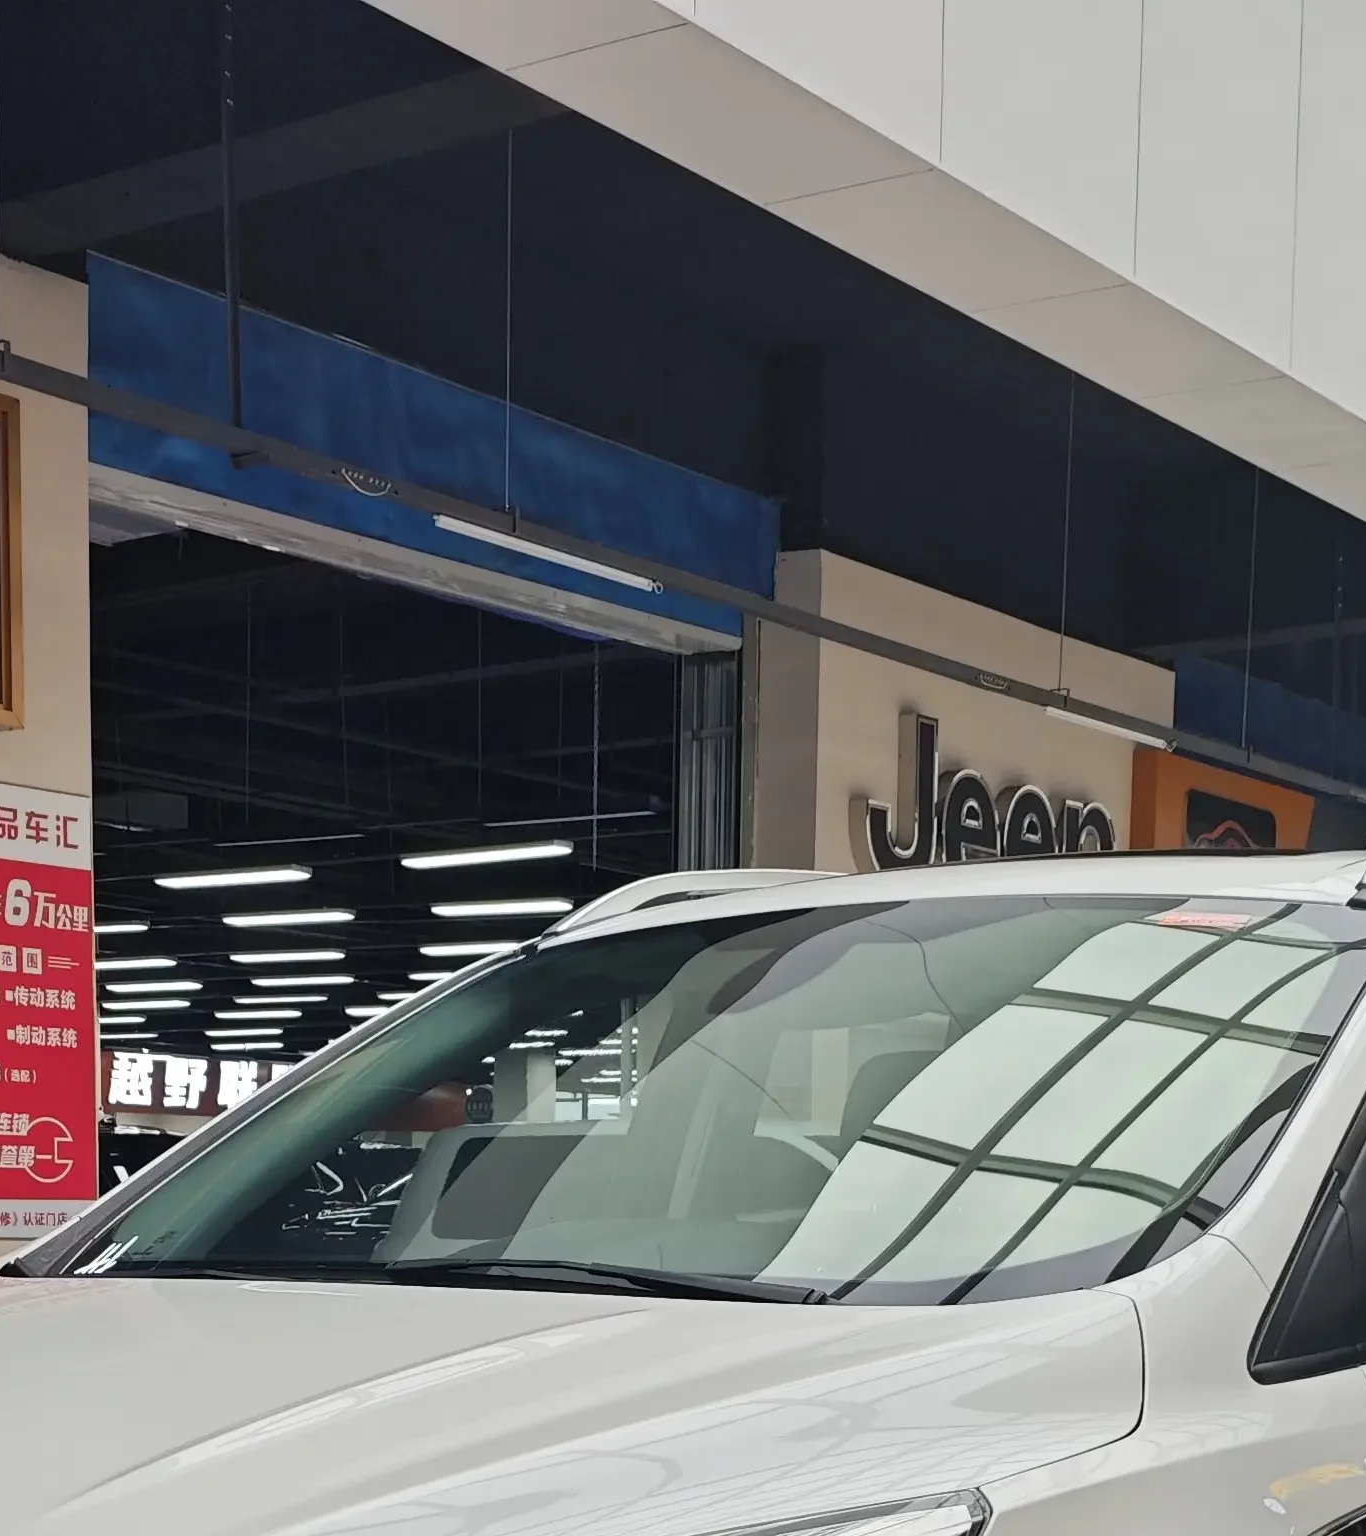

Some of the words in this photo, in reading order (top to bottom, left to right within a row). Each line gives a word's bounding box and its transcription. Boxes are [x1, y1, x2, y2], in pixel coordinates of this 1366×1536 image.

[13, 984, 76, 1011] 传动系统
[15, 1023, 79, 1049] 制动系统
[108, 1050, 296, 1110] 越野联
